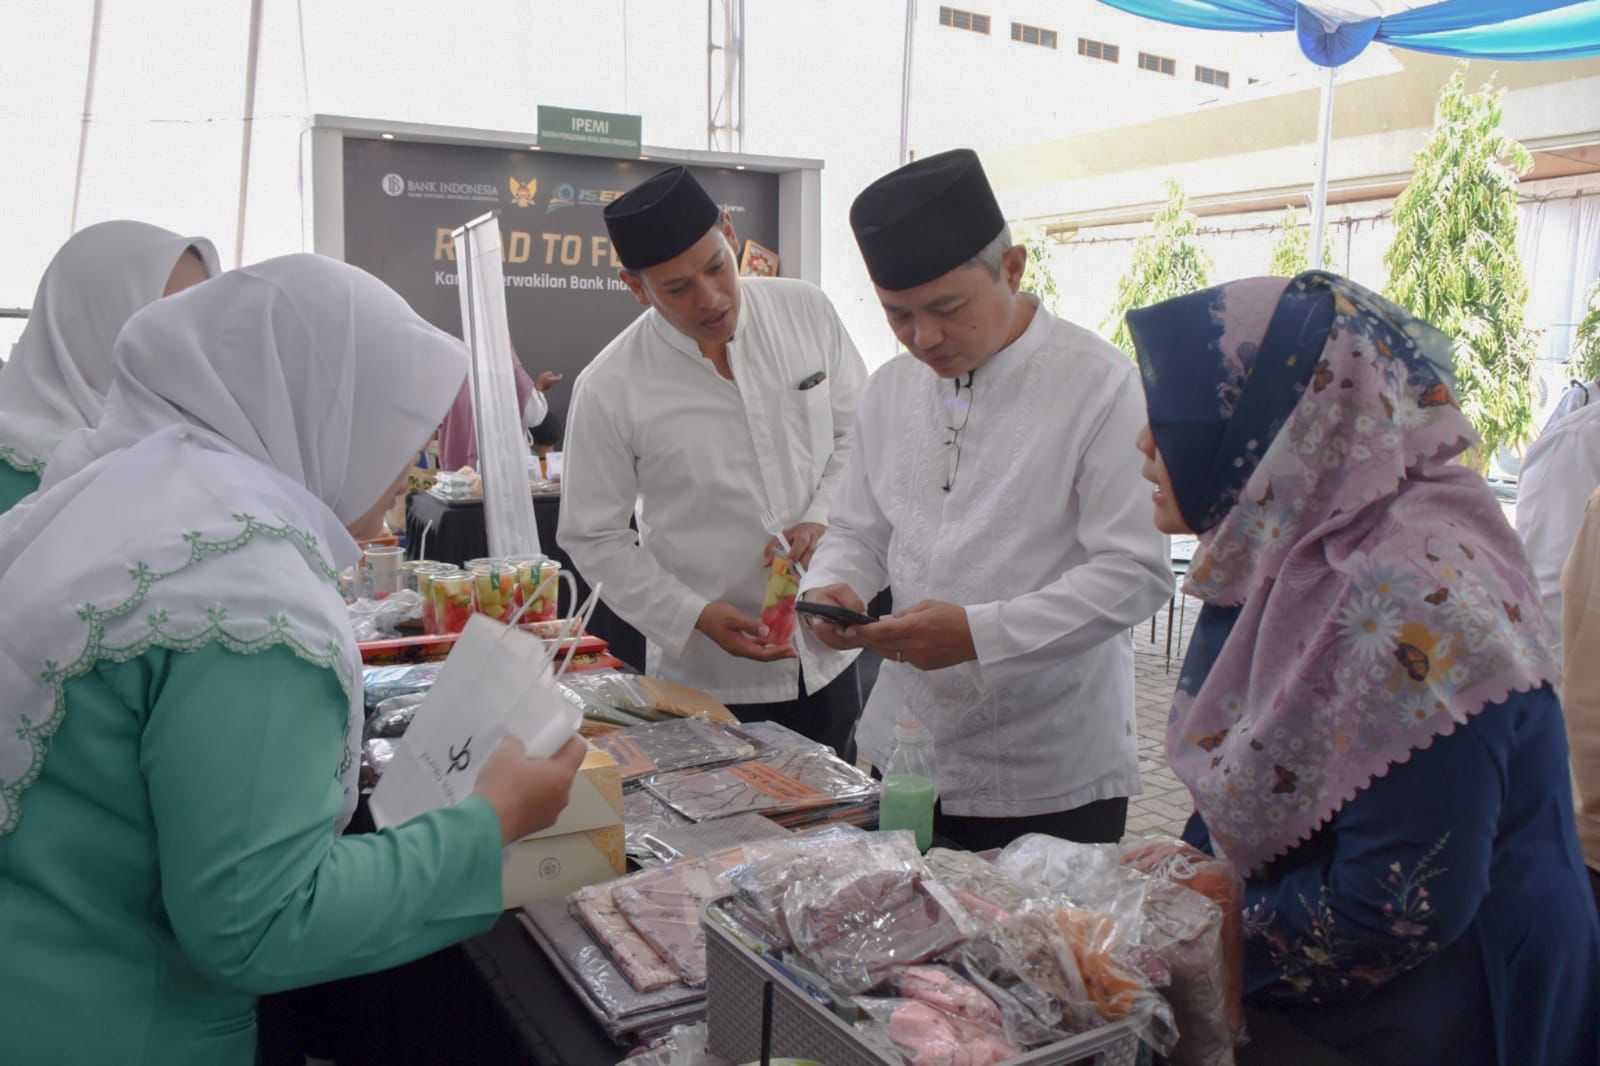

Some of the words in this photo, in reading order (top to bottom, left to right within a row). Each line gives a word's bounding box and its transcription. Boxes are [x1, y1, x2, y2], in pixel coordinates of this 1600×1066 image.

[571, 117, 609, 135] IPEMI
[407, 180, 437, 193] BANK
[439, 182, 499, 196] INDONESIA
[433, 228, 532, 264] RD
[542, 232, 583, 266] TO
[503, 272, 567, 289] rwakilan
[570, 275, 604, 290] Bank
